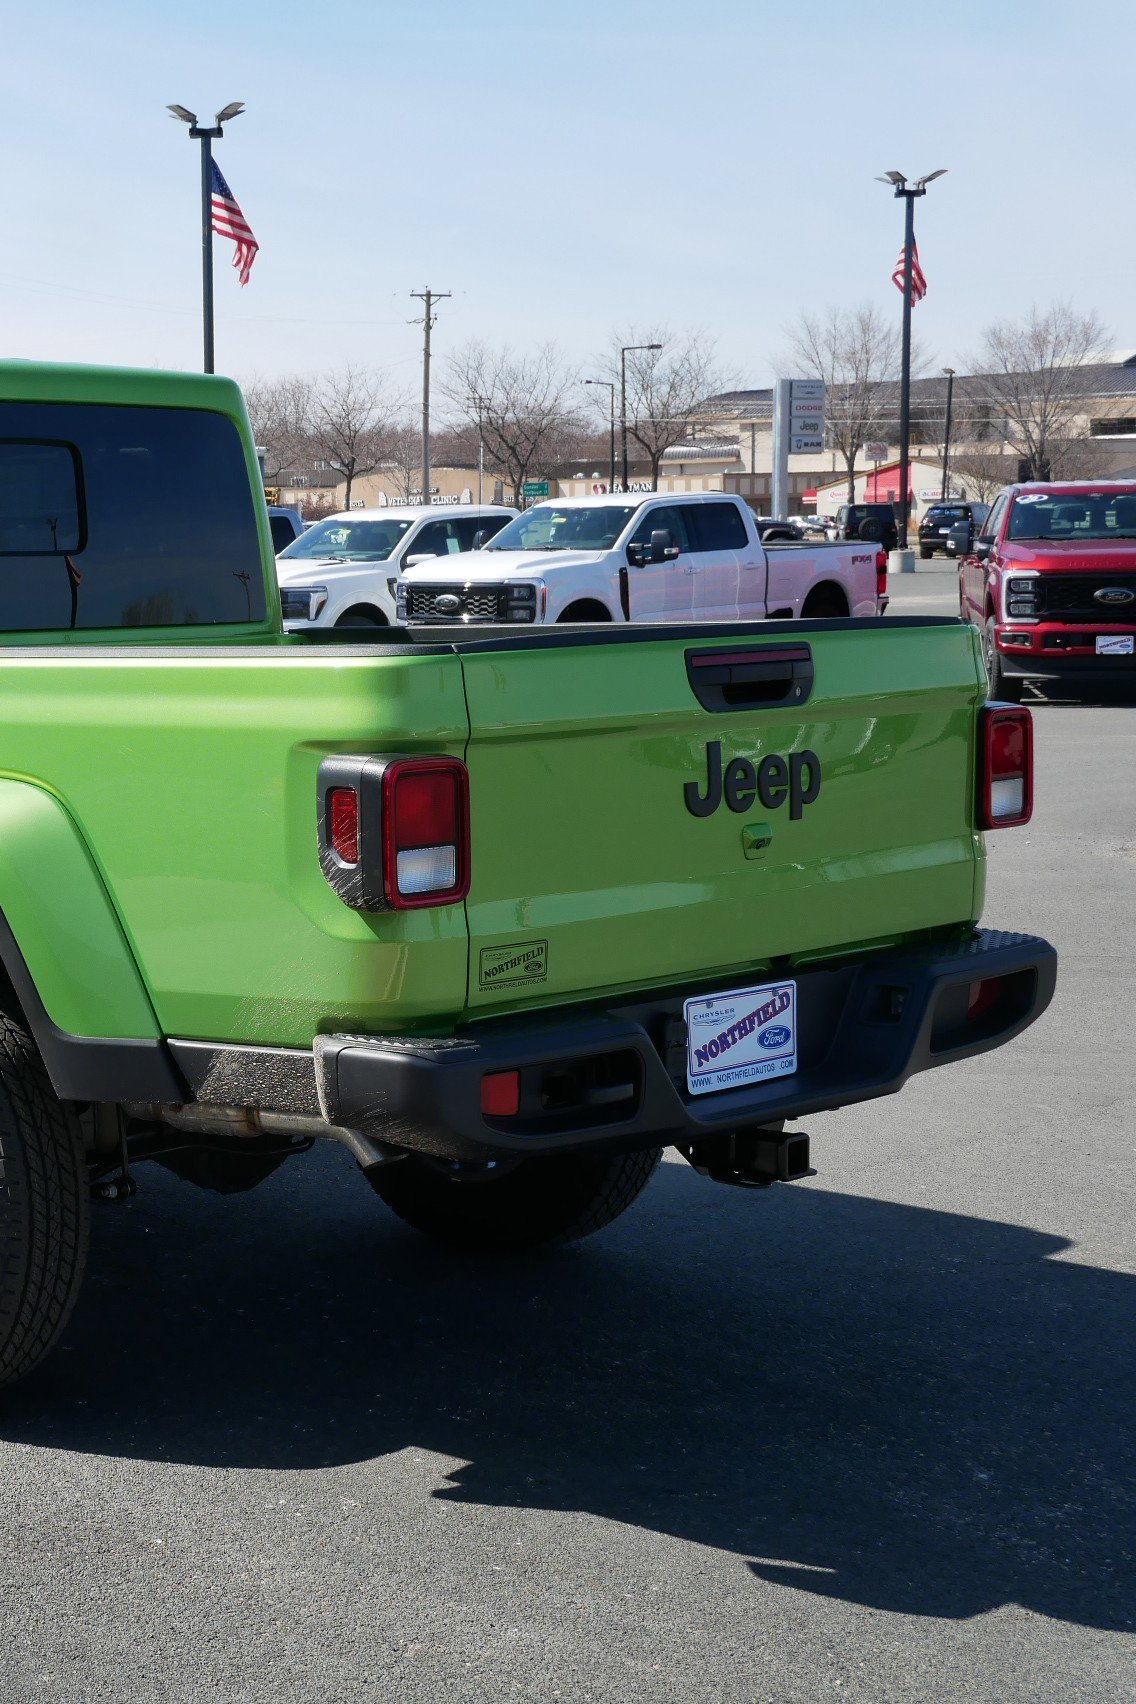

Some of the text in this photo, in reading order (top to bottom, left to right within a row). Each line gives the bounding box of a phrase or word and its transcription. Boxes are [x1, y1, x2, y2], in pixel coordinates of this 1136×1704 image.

[800, 420, 819, 432] Jeep
[606, 482, 653, 493] HEATMAN
[431, 495, 458, 504] CLINIC
[852, 554, 872, 565] FX4
[1099, 637, 1131, 649] NORTHFIELD
[684, 741, 821, 820] Jeep
[484, 946, 544, 980] NORTHFIELD
[693, 1008, 735, 1020] CHRYSLER
[694, 991, 791, 1068] NORTHFIELD
[764, 1029, 785, 1046] Ford
[691, 1076, 713, 1089] WWW.
[716, 1063, 775, 1084] NORTHFIELDAUTOS
